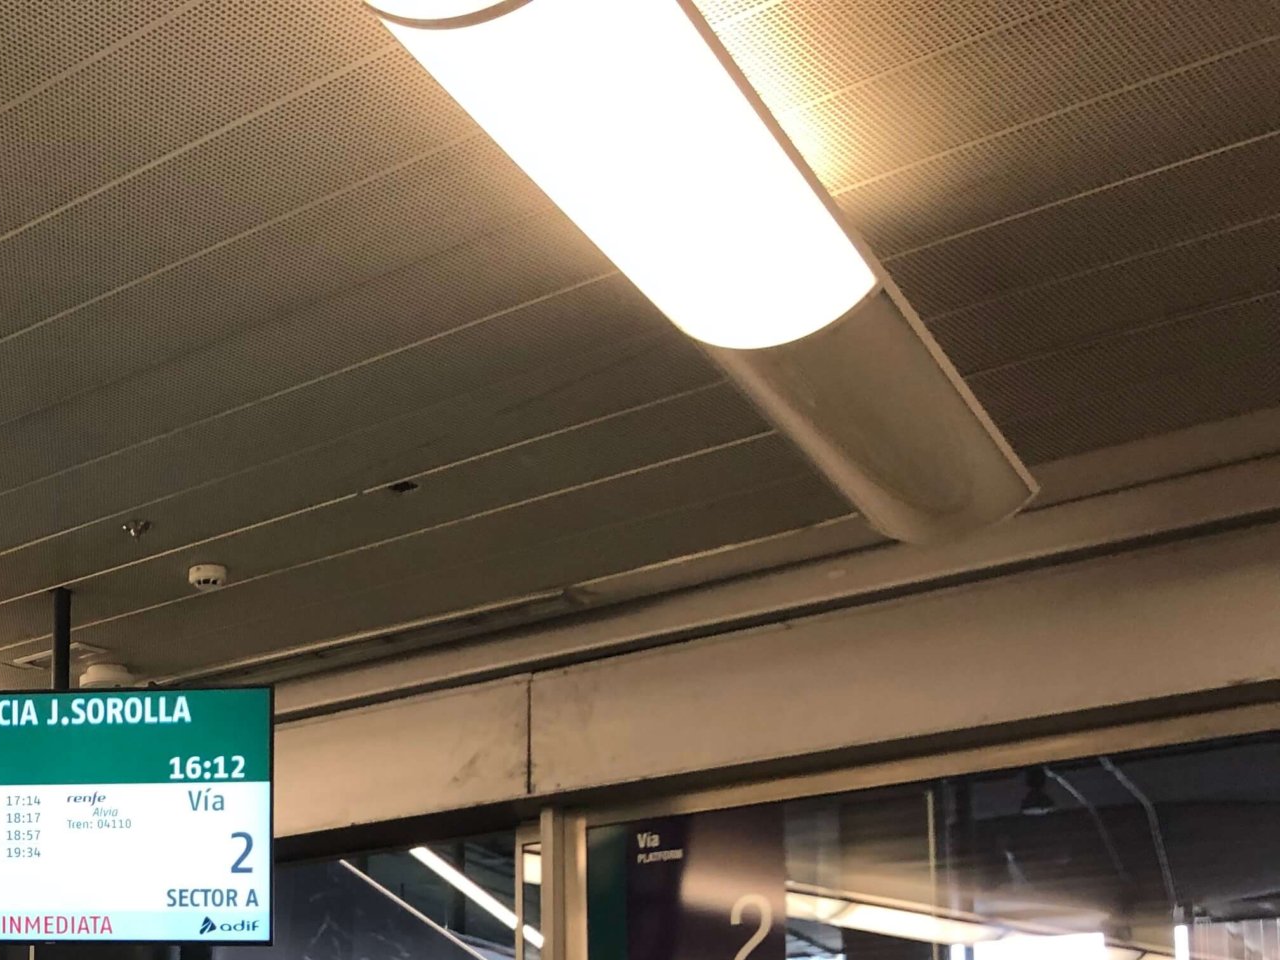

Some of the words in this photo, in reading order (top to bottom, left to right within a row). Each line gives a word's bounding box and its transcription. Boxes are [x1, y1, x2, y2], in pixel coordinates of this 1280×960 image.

[46, 695, 192, 726] J.SOROLLA
[169, 755, 246, 780] 16:12
[6, 795, 41, 807] 17:14
[66, 791, 107, 806] renfe
[188, 788, 225, 811] Vía
[6, 812, 41, 824] 18:17
[92, 807, 119, 818] Alvia
[66, 819, 93, 830] Tren:
[97, 818, 132, 829] 04110
[6, 829, 41, 841] 18:57
[6, 847, 41, 858] 19:34
[230, 831, 254, 874] 2
[166, 888, 238, 908] SECTOR
[245, 888, 260, 908] A
[1, 915, 113, 935] INMEDIATA
[219, 919, 261, 933] adif
